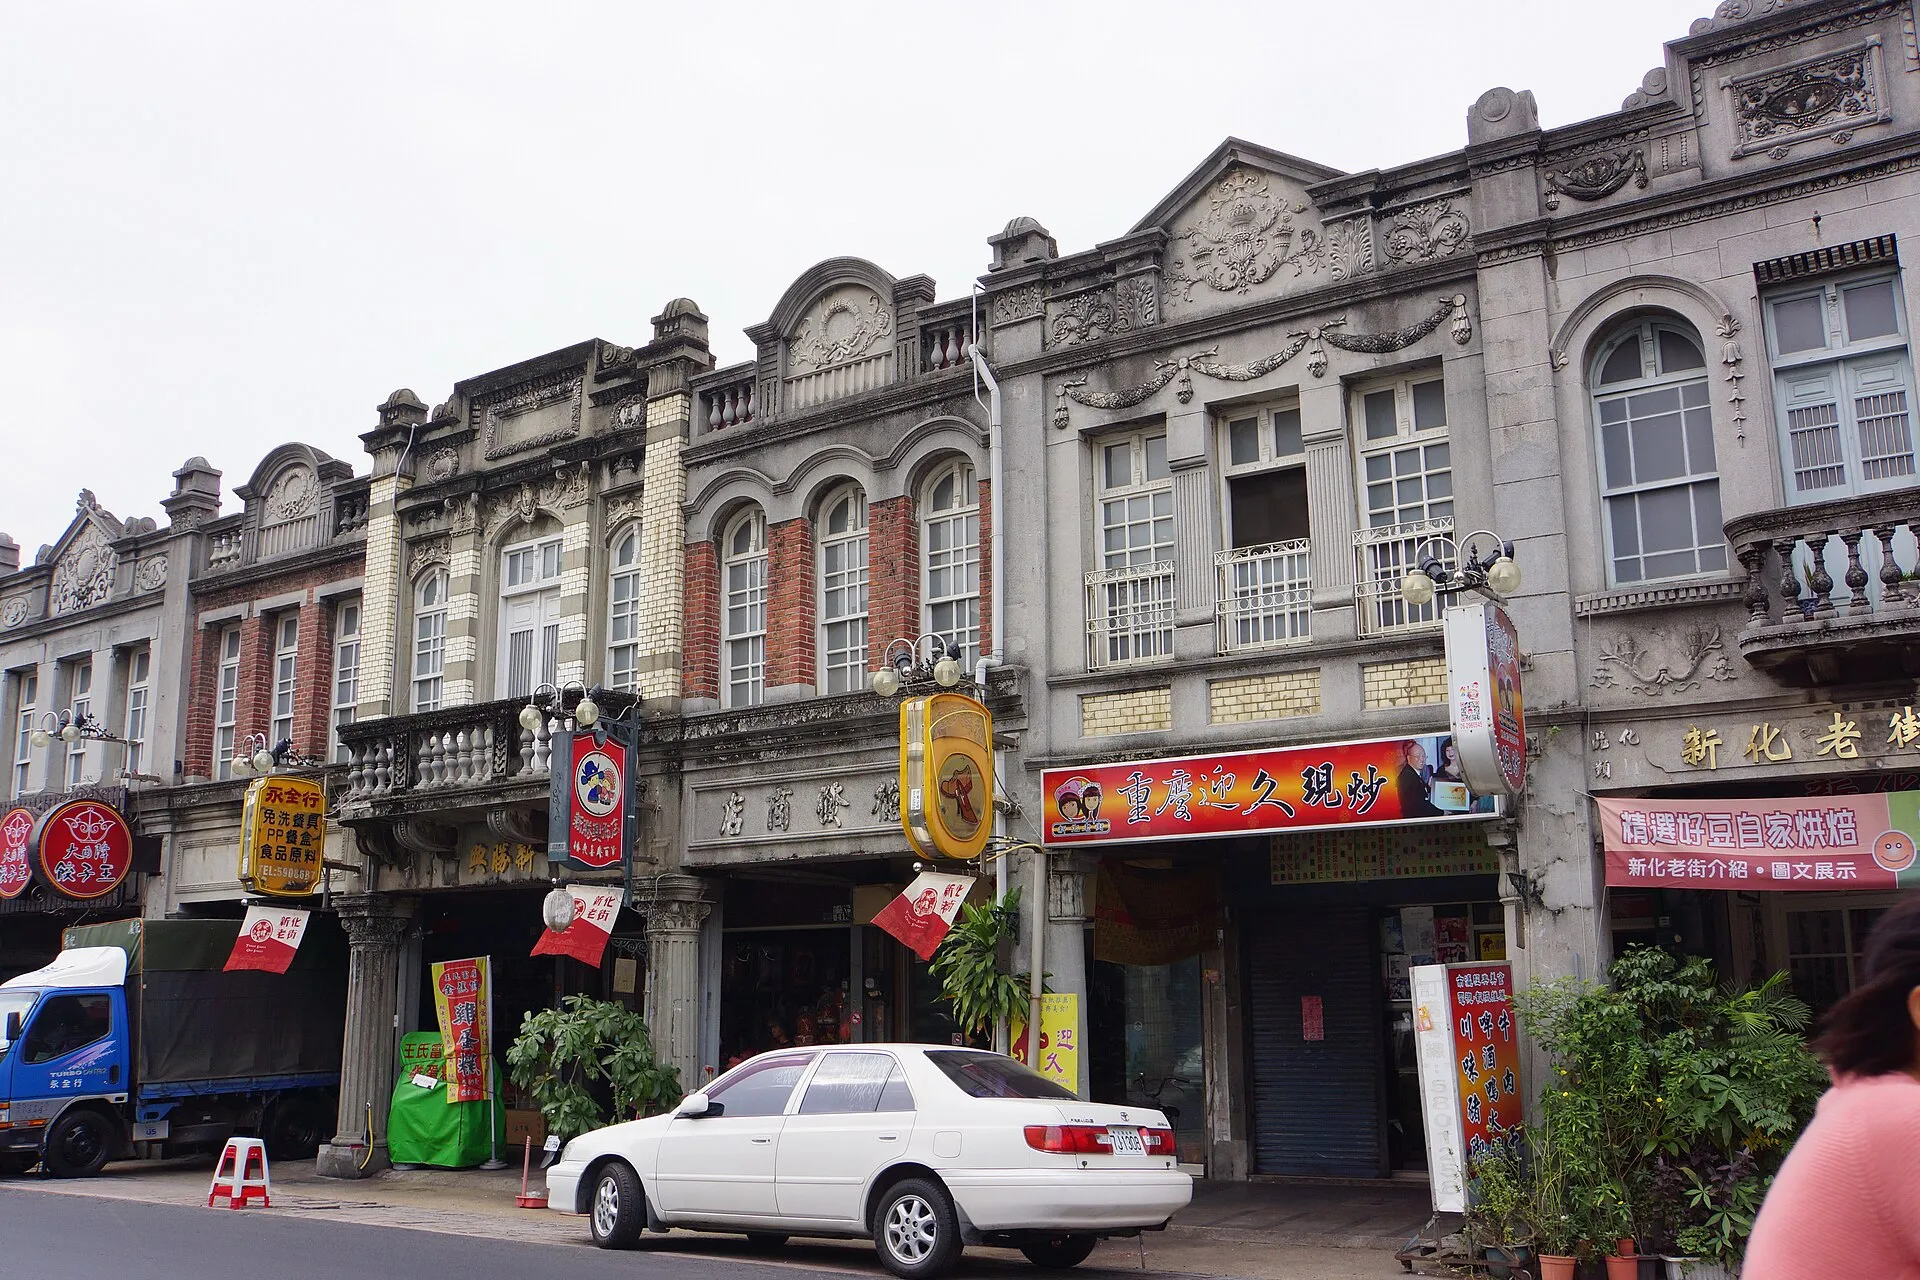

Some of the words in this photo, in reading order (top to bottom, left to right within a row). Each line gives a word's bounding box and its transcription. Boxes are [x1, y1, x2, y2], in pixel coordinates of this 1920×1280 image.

[1681, 706, 1920, 770] 新化老街
[265, 786, 320, 808] 永全行
[1117, 761, 1388, 824] 重慶迎久現炒
[263, 809, 322, 830] 免洗餐具
[1620, 807, 1859, 850] 精選好豆自家烘焙
[267, 828, 313, 847] PP餐盒
[260, 843, 316, 865] 食品原料
[54, 861, 116, 883] 餃子王
[593, 895, 616, 908] 新化
[280, 916, 301, 928] 新化
[587, 907, 611, 921] 老街
[277, 929, 298, 940] 老街
[452, 1001, 481, 1077] 雞蛋糕
[49, 1079, 83, 1089] 永全行
[50, 1070, 82, 1078] TURBO
